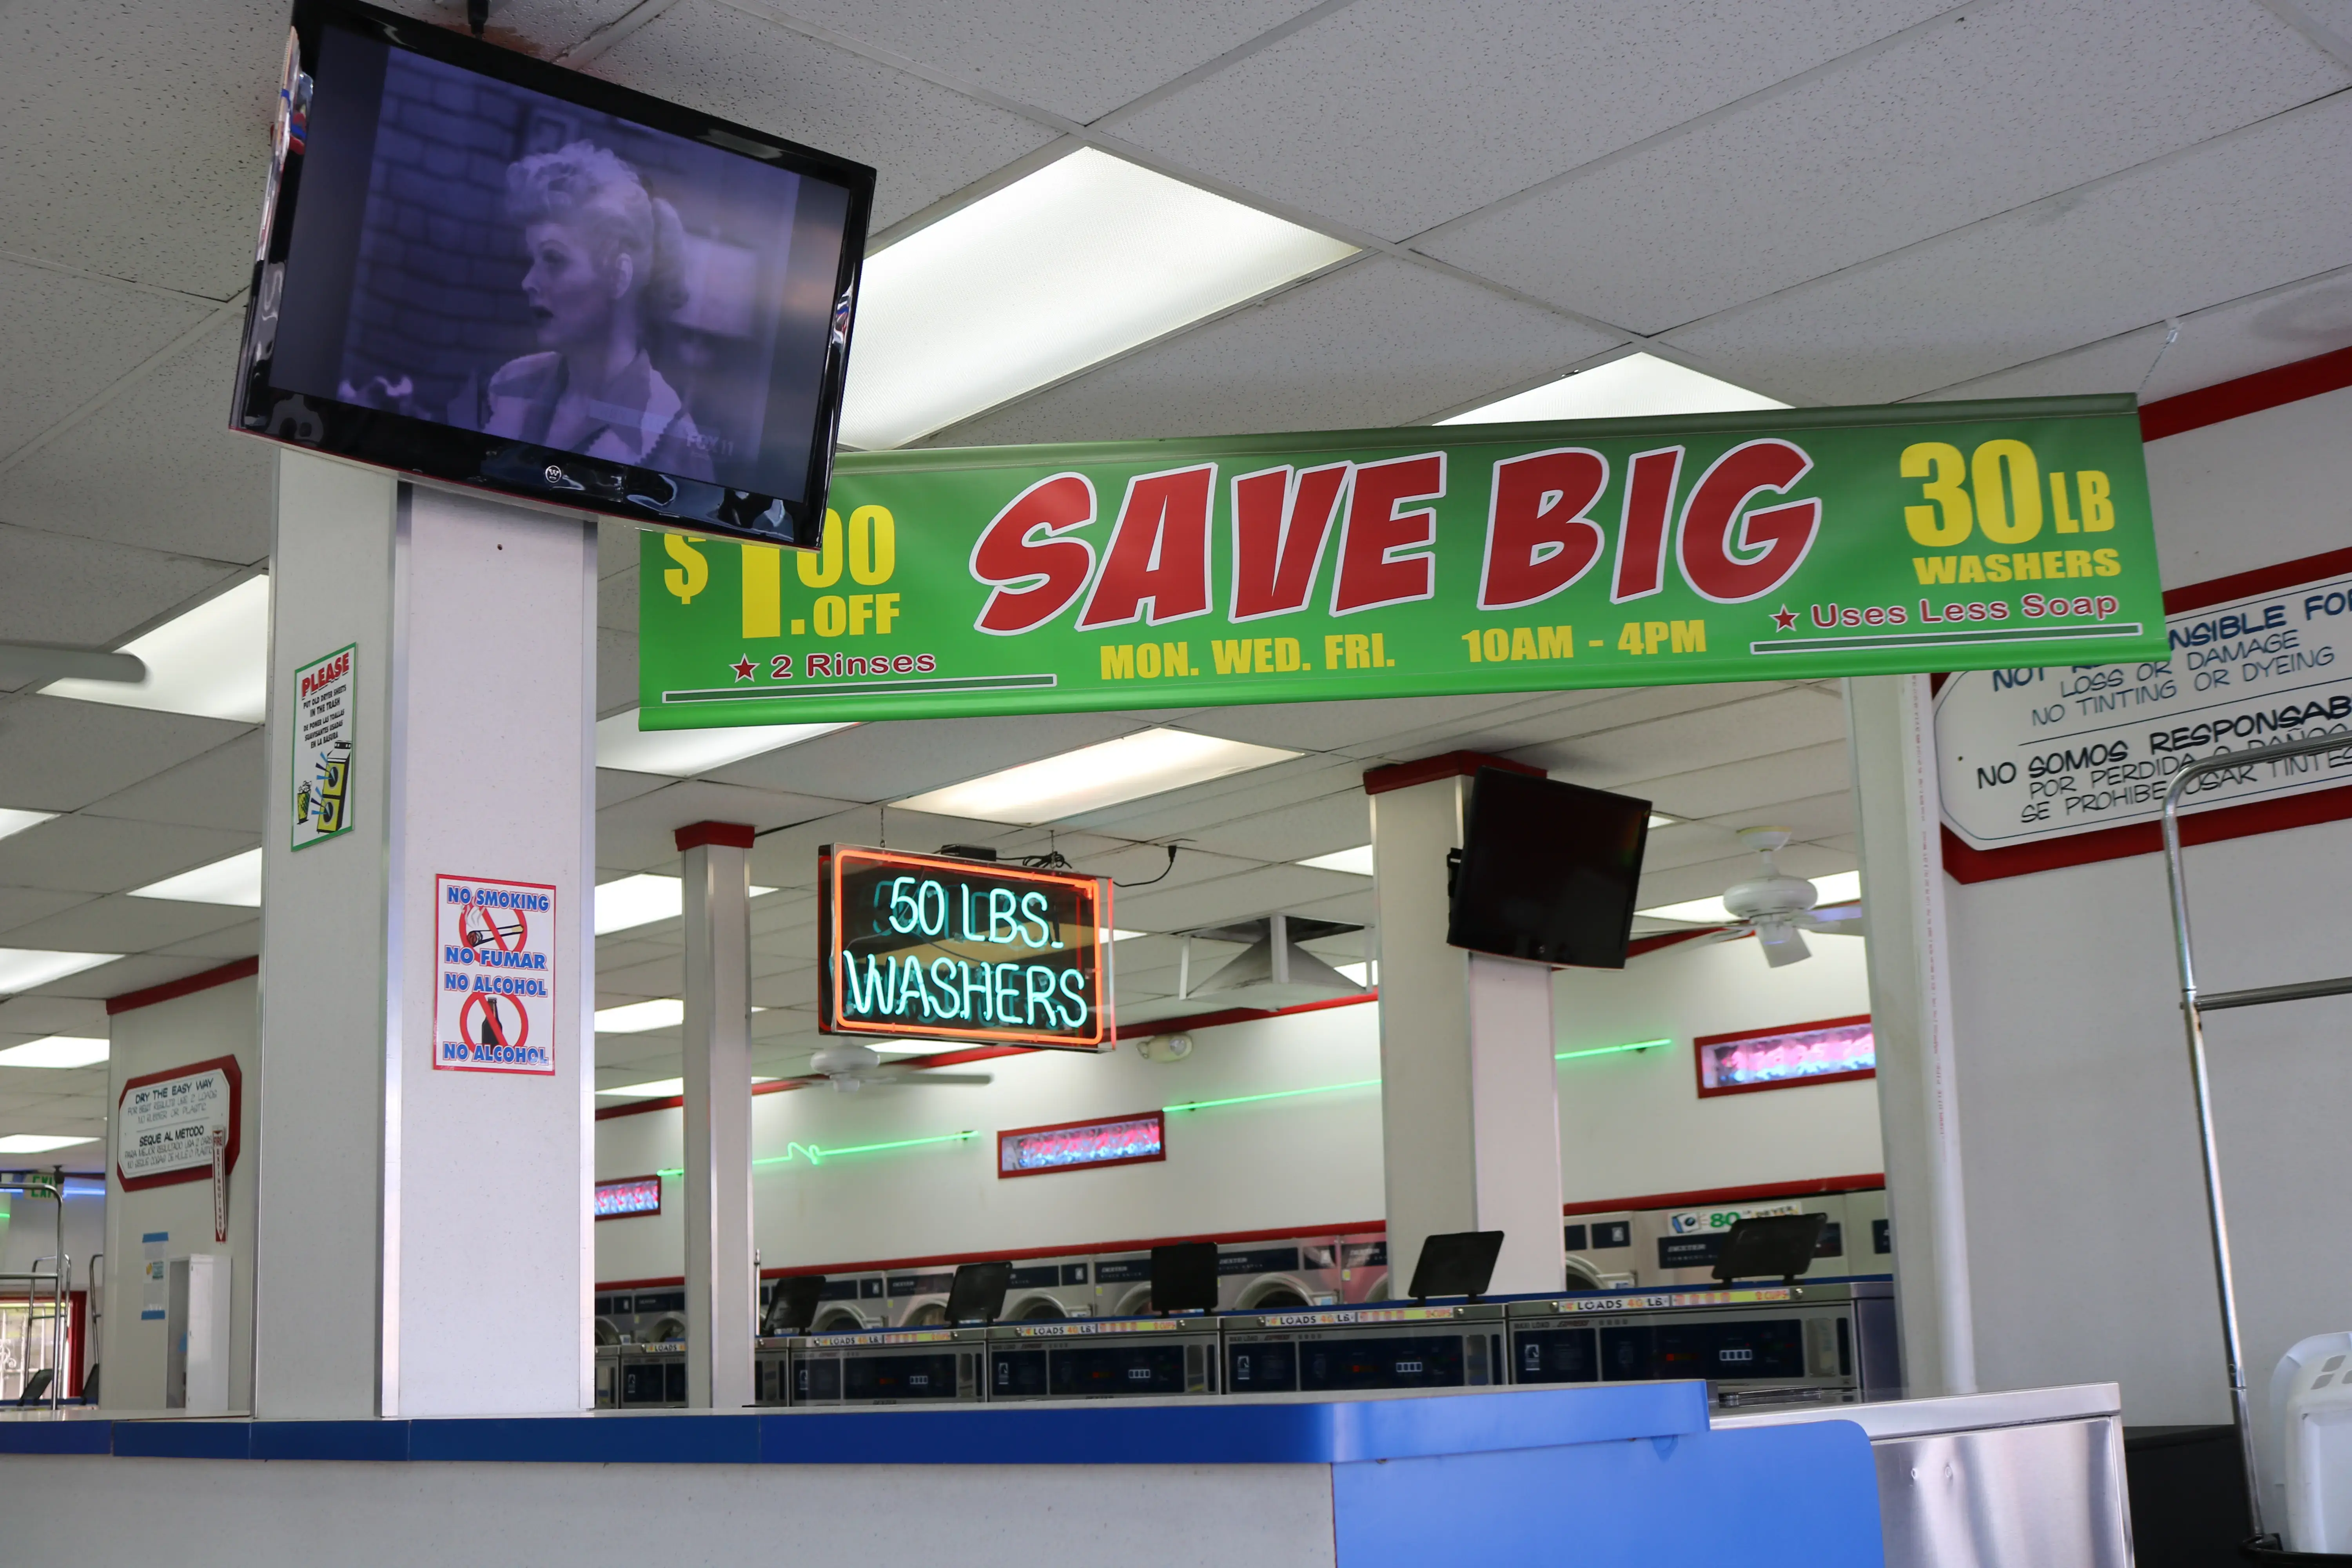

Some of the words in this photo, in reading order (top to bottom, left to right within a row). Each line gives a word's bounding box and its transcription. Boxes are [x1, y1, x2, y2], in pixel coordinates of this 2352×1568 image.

[1899, 439, 2042, 547] 30
[2051, 470, 2115, 534] LB
[969, 451, 1446, 636] SAVE
[1477, 438, 1821, 611] BIG
[1912, 548, 2121, 585] WASHERS
[1810, 603, 1908, 631] Uses
[1921, 597, 2009, 625] Less
[2021, 593, 2120, 624] Soap
[1461, 625, 1573, 663] 10AM
[1617, 619, 1707, 655] 4PM
[770, 655, 793, 679] 2
[806, 652, 936, 678] Rinses
[1100, 643, 1199, 681] MON.
[1211, 637, 1311, 675] WED.
[1325, 633, 1395, 670] FRI.
[2060, 669, 2123, 698] LOSS
[2137, 661, 2172, 681] OR
[2187, 629, 2300, 670] DAMAGE
[301, 652, 350, 699] PLEASE
[2032, 704, 2065, 726] NO
[2076, 679, 2178, 716] TINTING
[2194, 669, 2230, 691] OR
[2242, 646, 2335, 682] DYEING
[321, 691, 332, 702] DRYER
[334, 684, 347, 696] SHEETS
[309, 719, 322, 730] PONER
[330, 709, 345, 721] TOALLAS
[310, 708, 316, 717] IN
[317, 704, 325, 714] THE
[326, 697, 340, 710] TRASH
[330, 720, 343, 731] USADAS
[311, 740, 316, 749] EN
[323, 731, 338, 743] BASURA
[1976, 762, 2018, 789] NO
[2027, 740, 2129, 779] SOMOS
[2030, 776, 2077, 800] POR
[2092, 751, 2198, 789] PERDIDA
[2020, 802, 2050, 823] SE
[2066, 779, 2168, 816] PROHIBE
[447, 885, 471, 905] NO
[475, 887, 550, 913] SMOKING
[889, 876, 946, 936] 50
[961, 883, 1064, 950] LBS.
[445, 945, 475, 964] NO
[479, 948, 548, 971] FUMAR
[445, 972, 470, 992] NO
[472, 974, 548, 998] ALCOHOL
[842, 949, 1088, 1028] WASHERS
[443, 1041, 469, 1062] NO
[472, 1043, 549, 1065] ALCOHOL
[136, 1093, 151, 1104] DRY
[153, 1088, 168, 1100] THE
[172, 1082, 192, 1096] EASY
[196, 1078, 214, 1089] WAY
[139, 1133, 162, 1147] SEQUE
[164, 1132, 173, 1142] AL
[175, 1125, 204, 1140] METODO
[1710, 1212, 1741, 1228] 80
[1578, 1301, 1622, 1310] LOADS
[1627, 1299, 1643, 1308] 40
[1764, 1289, 1787, 1299] CUPS
[1034, 1326, 1064, 1335] LOADS
[1280, 1316, 1316, 1325] LOADS
[829, 1336, 855, 1345] LOADS
